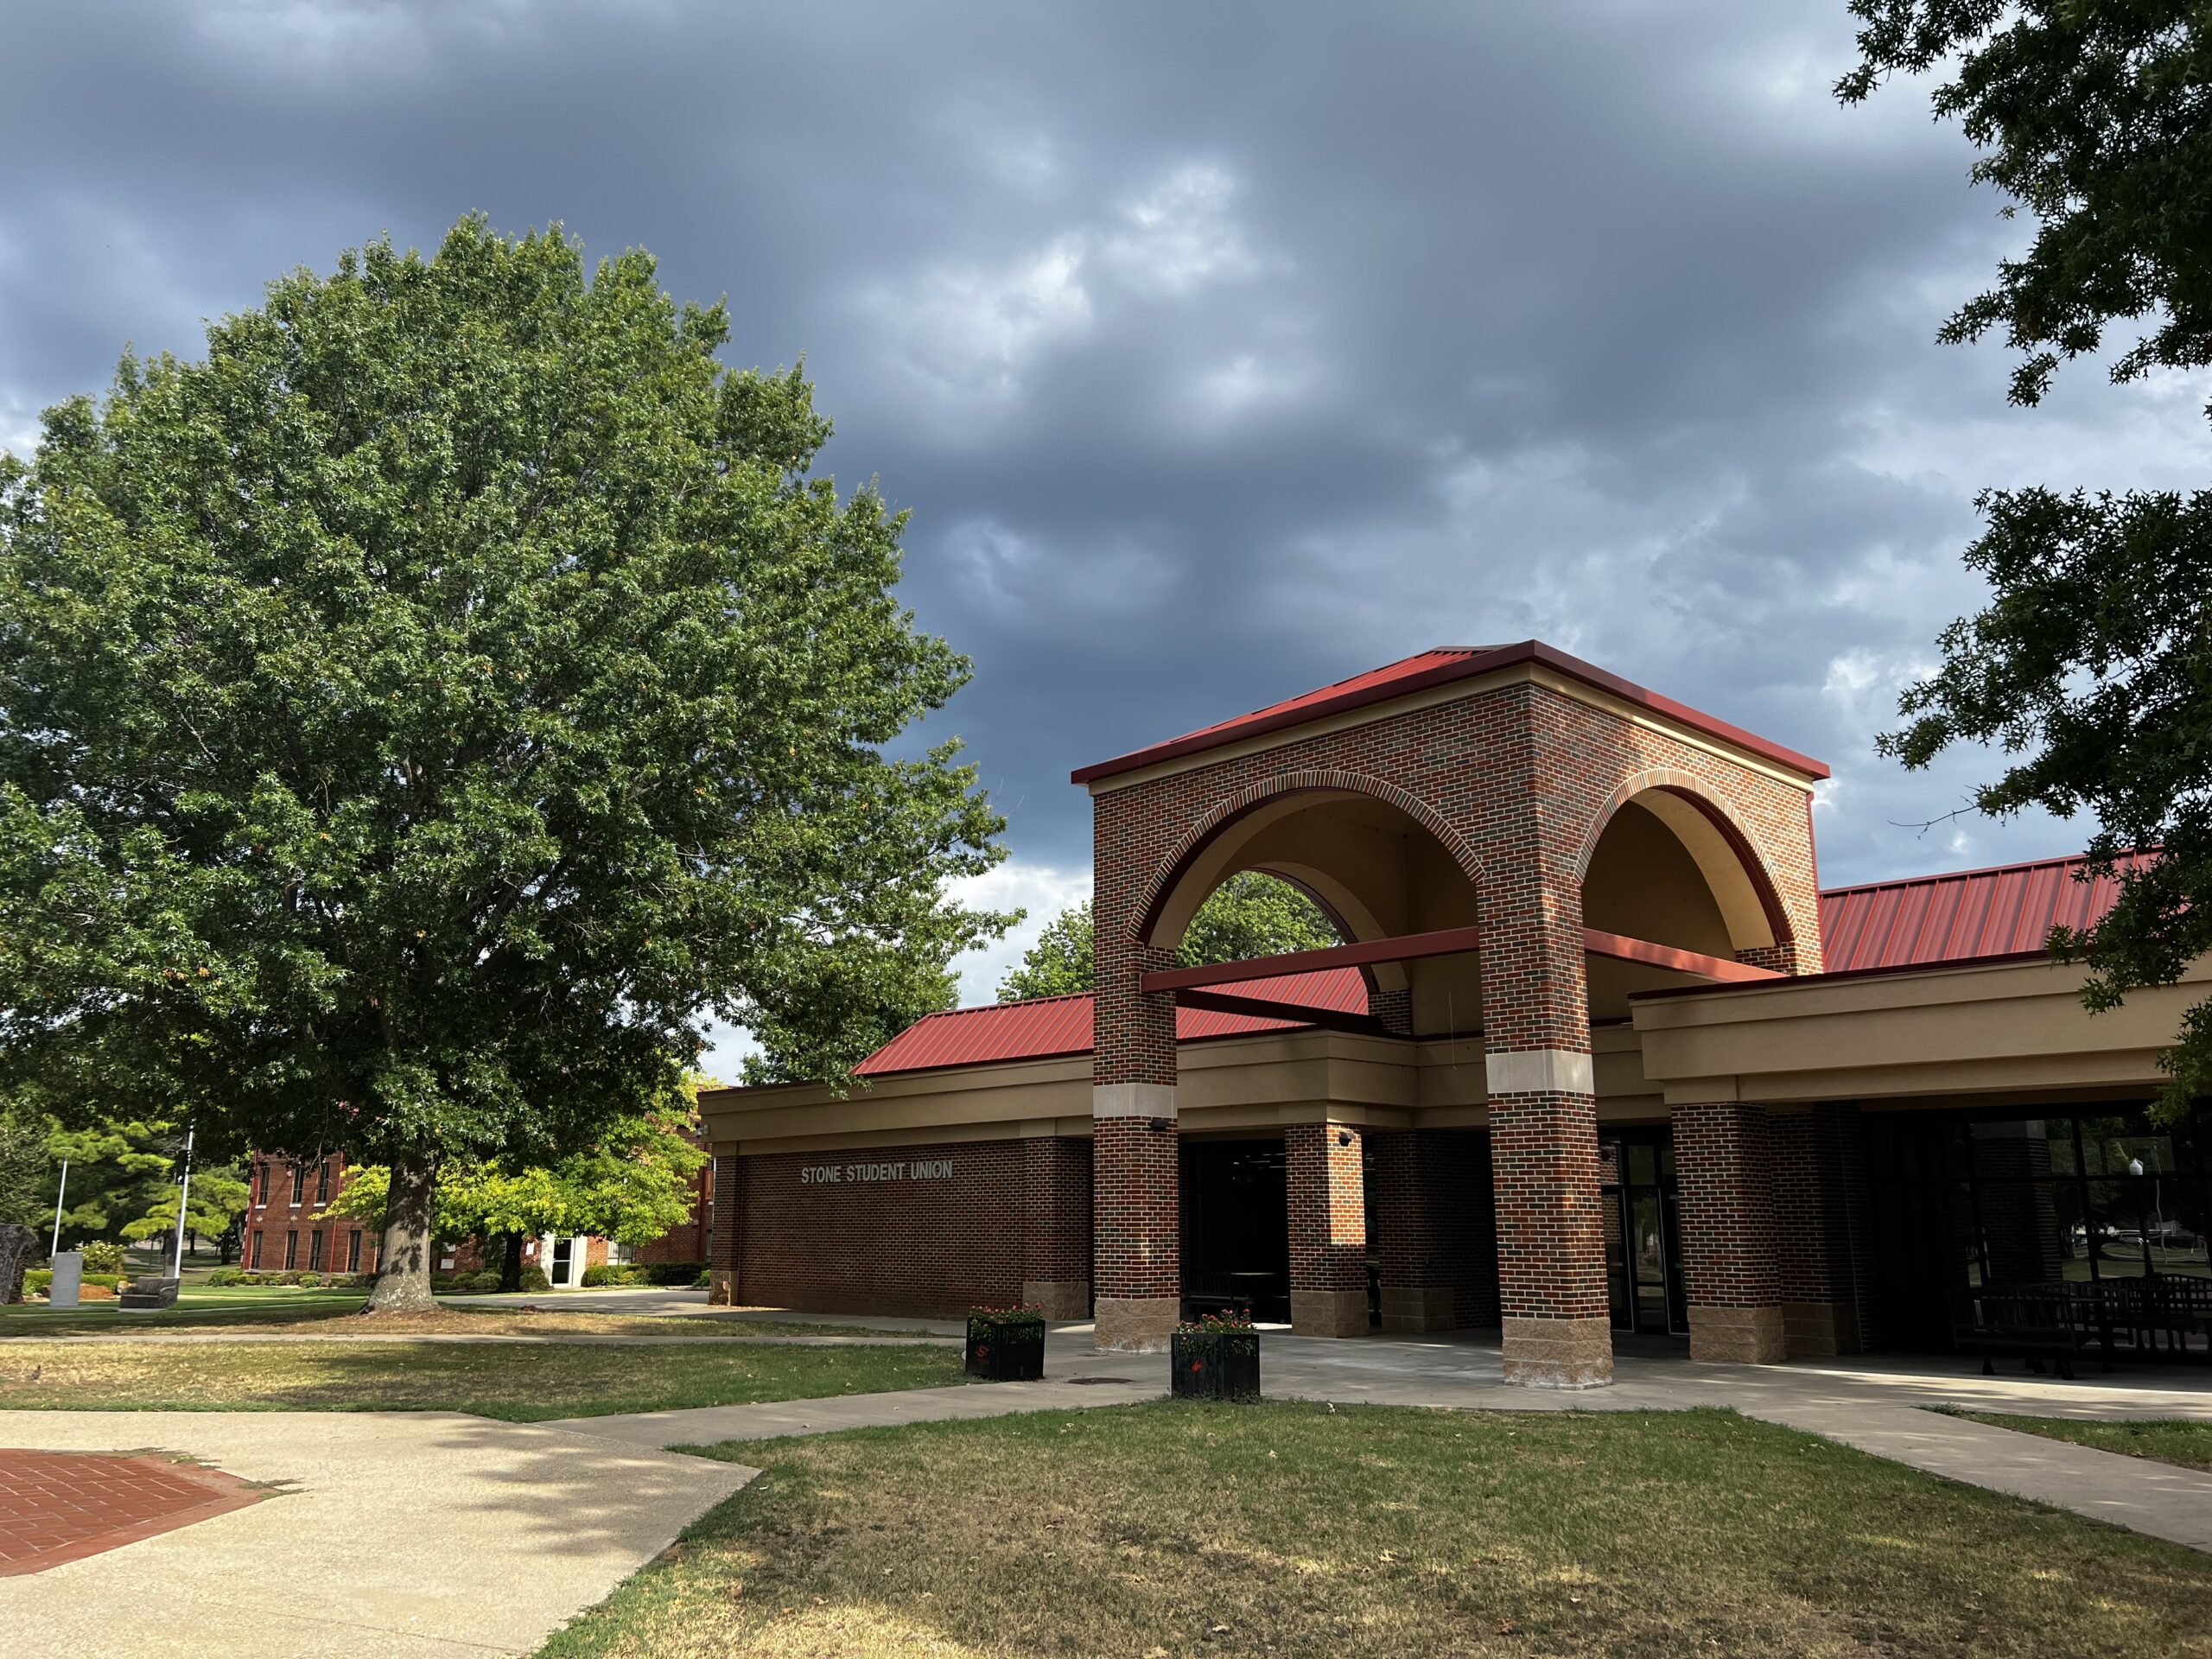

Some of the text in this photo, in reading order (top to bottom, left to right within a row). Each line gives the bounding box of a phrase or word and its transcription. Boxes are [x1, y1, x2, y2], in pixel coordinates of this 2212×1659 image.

[801, 1160, 952, 1184] STONE STUDENT UNION
